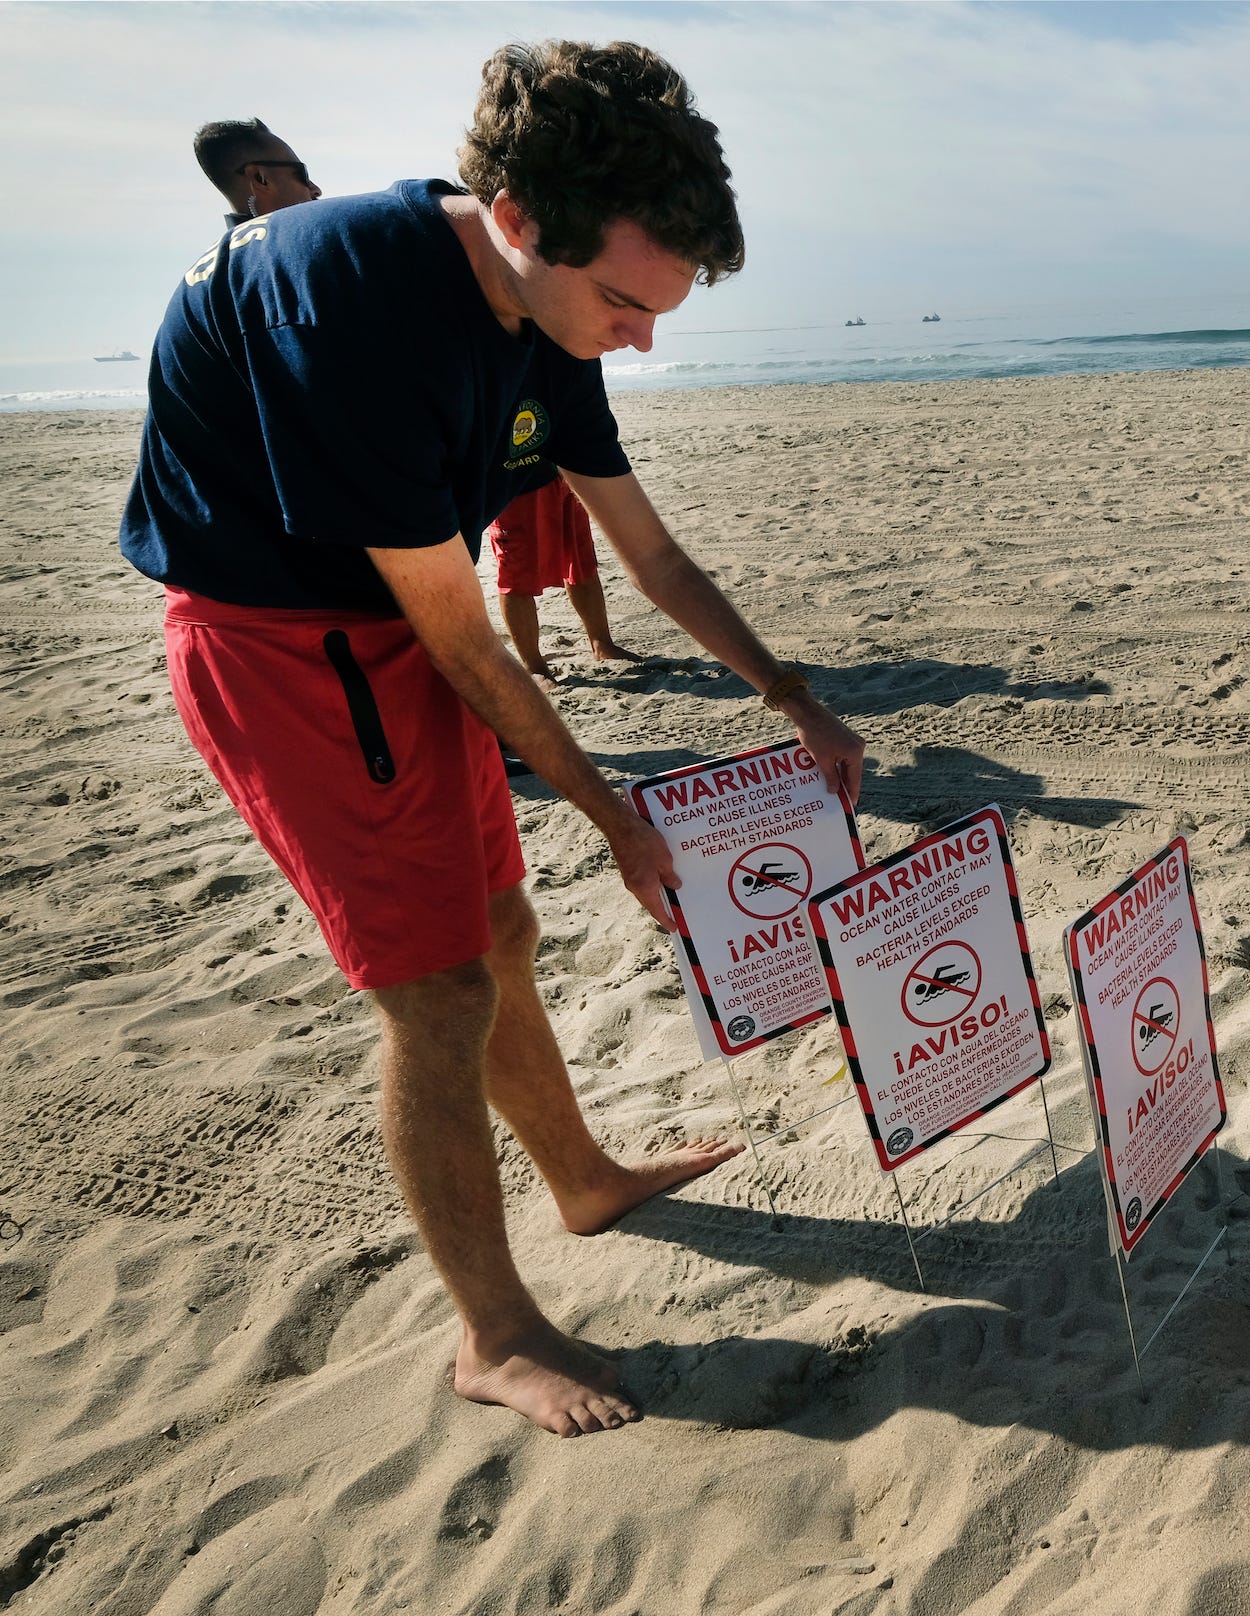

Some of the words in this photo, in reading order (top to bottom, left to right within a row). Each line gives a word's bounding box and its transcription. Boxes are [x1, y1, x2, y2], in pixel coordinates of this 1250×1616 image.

[654, 747, 817, 813] WARNING
[664, 807, 704, 826] OCEAN
[706, 794, 747, 813] WATER
[749, 778, 796, 800] CONTACT
[800, 770, 820, 785] MAY
[709, 808, 746, 826] CAUSE
[748, 794, 792, 814] ILLNESS
[681, 826, 738, 851] BACTERIA
[740, 814, 781, 833] LEVELS
[784, 800, 824, 820] EXCEED
[702, 837, 747, 858] HEALTH
[749, 817, 812, 842] STANDARDS
[830, 828, 989, 926] WARNING
[840, 914, 880, 942] OCEAN
[882, 892, 920, 920] WATER
[921, 865, 966, 897] CONTACT
[970, 854, 991, 871] MAY
[884, 908, 920, 934] CAUSE
[921, 884, 959, 914] ILLNESS
[1084, 856, 1179, 956] WARNING
[727, 918, 806, 961] ¡AVIS
[856, 932, 913, 967] BACTERIA
[914, 907, 950, 936] LEVELS
[951, 885, 990, 912] EXCEED
[877, 941, 920, 971] HEALTH
[922, 904, 978, 946] STANDARDS
[1088, 945, 1113, 975] OCEAN
[1114, 923, 1138, 952] WATER
[1139, 895, 1167, 928] CONTACT
[1168, 883, 1180, 902] MAY
[1115, 940, 1137, 968] CAUSE
[1138, 916, 1164, 946] ILLNESS
[714, 975, 726, 985] EL
[727, 956, 773, 980] CONTACTO
[775, 948, 793, 961] CON
[723, 997, 741, 1010] LOS
[742, 982, 778, 1002] NIVELES
[779, 976, 792, 988] DE
[732, 974, 761, 992] PUEDE
[762, 960, 796, 980] CAUSAR
[1098, 965, 1132, 1004] BACTERIA
[1134, 940, 1157, 970] LEVELS
[1158, 918, 1182, 947] EXCEED
[1112, 976, 1138, 1009] HEALTH
[1139, 940, 1177, 982] STANDARDS
[747, 1000, 765, 1014] LOS
[766, 977, 820, 1006] ESTANDARES
[878, 1090, 889, 1100] EL
[891, 1063, 938, 1093] CONTACTO
[940, 1052, 958, 1067] CON
[961, 1040, 982, 1058] AGUA
[984, 1030, 998, 1044] DEL
[1000, 1008, 1028, 1033] OCEANO
[894, 995, 1009, 1075] ¡AVISO!
[894, 1083, 924, 1104] PUEDE
[925, 1064, 960, 1087] CAUSAR
[962, 1026, 1021, 1068] ENFERMEDADES
[885, 1109, 902, 1125] LOS
[904, 1088, 940, 1114] NIVELES
[942, 1081, 954, 1093] DE
[956, 1054, 999, 1086] BACTERIAS
[1001, 1032, 1034, 1059] EXCEDEN
[908, 1109, 925, 1124] LOS
[927, 1077, 982, 1113] ESTANDARES
[984, 1069, 994, 1082] DE
[996, 1053, 1020, 1074] SALUD
[1128, 1039, 1194, 1134] ¡AVISO!
